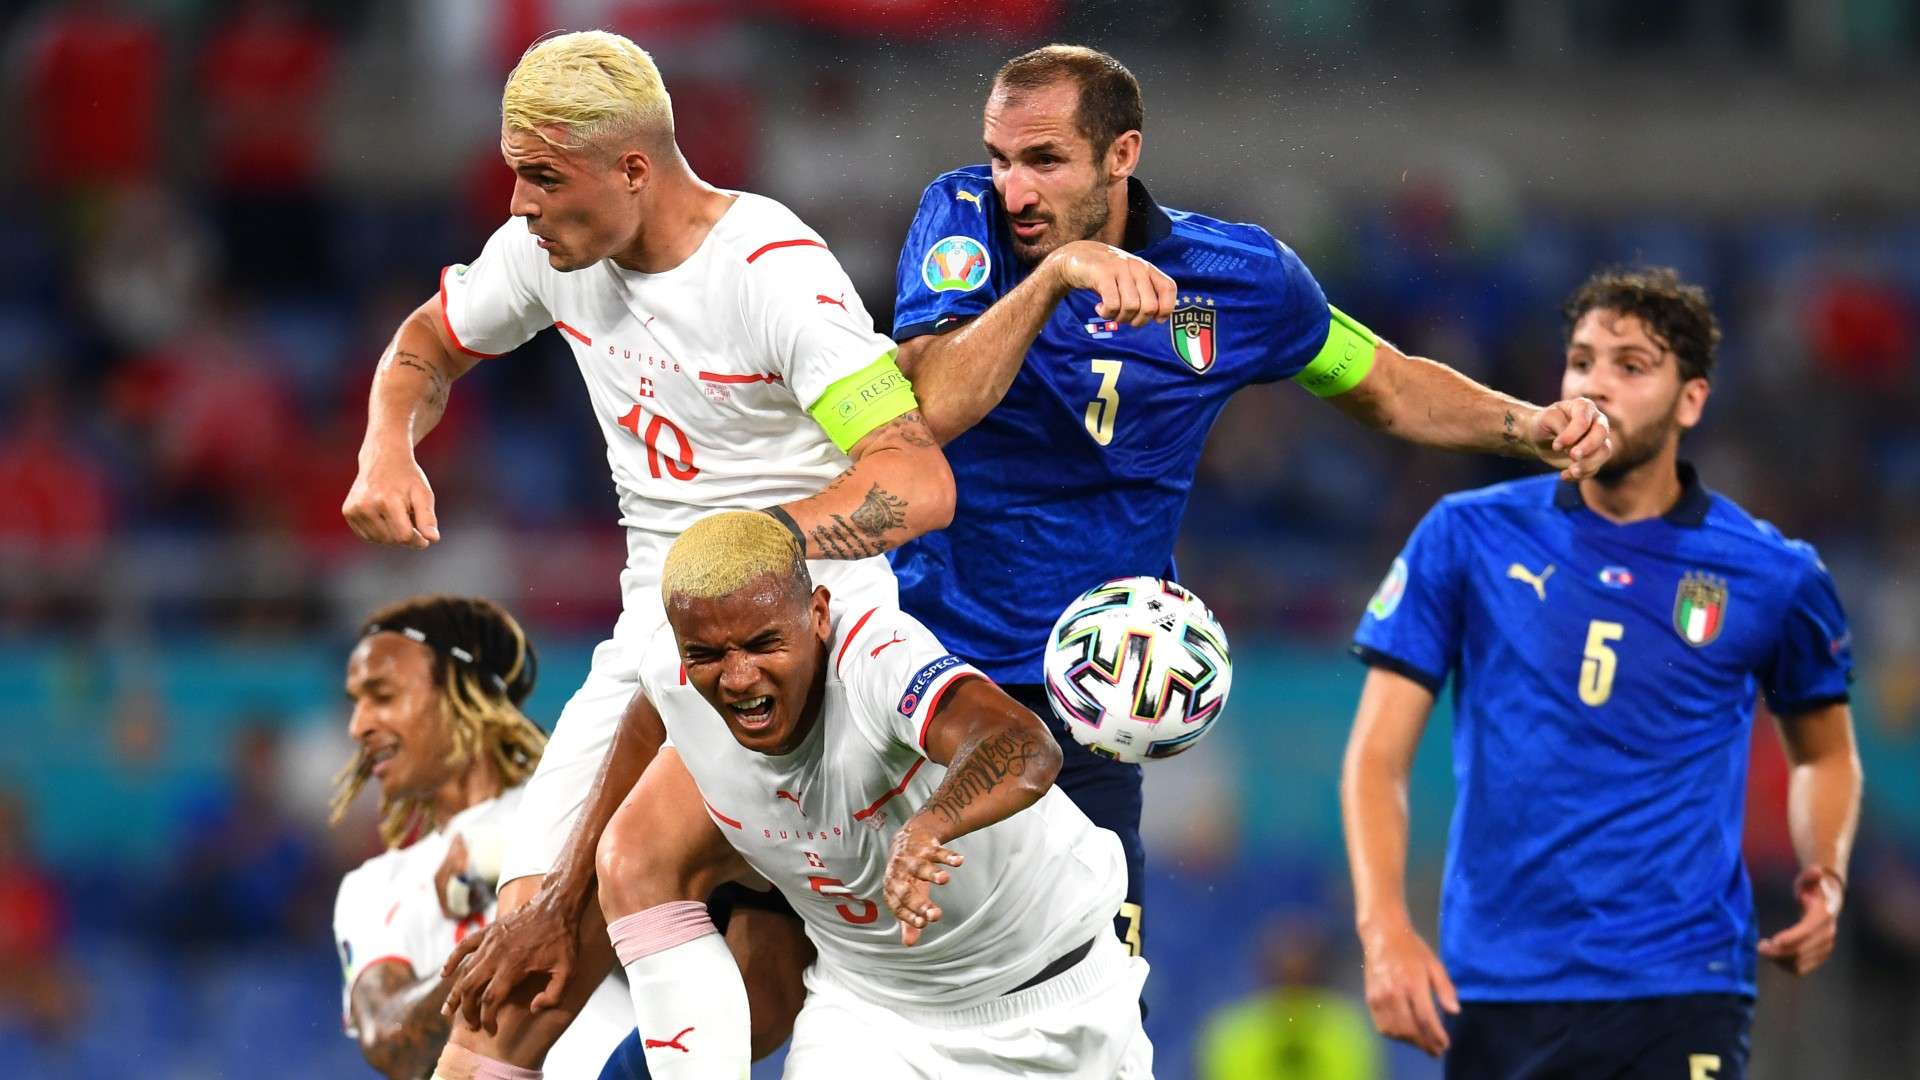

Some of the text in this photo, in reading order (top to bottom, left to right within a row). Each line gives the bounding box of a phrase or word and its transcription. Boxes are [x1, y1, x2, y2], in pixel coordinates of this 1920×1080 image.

[1174, 311, 1212, 324] ITALIA
[860, 371, 906, 402] RESPE
[1084, 359, 1124, 447] 3
[617, 404, 701, 481] 10
[912, 656, 960, 694] RESPECT
[1578, 619, 1624, 706] 5
[808, 876, 878, 924] 5
